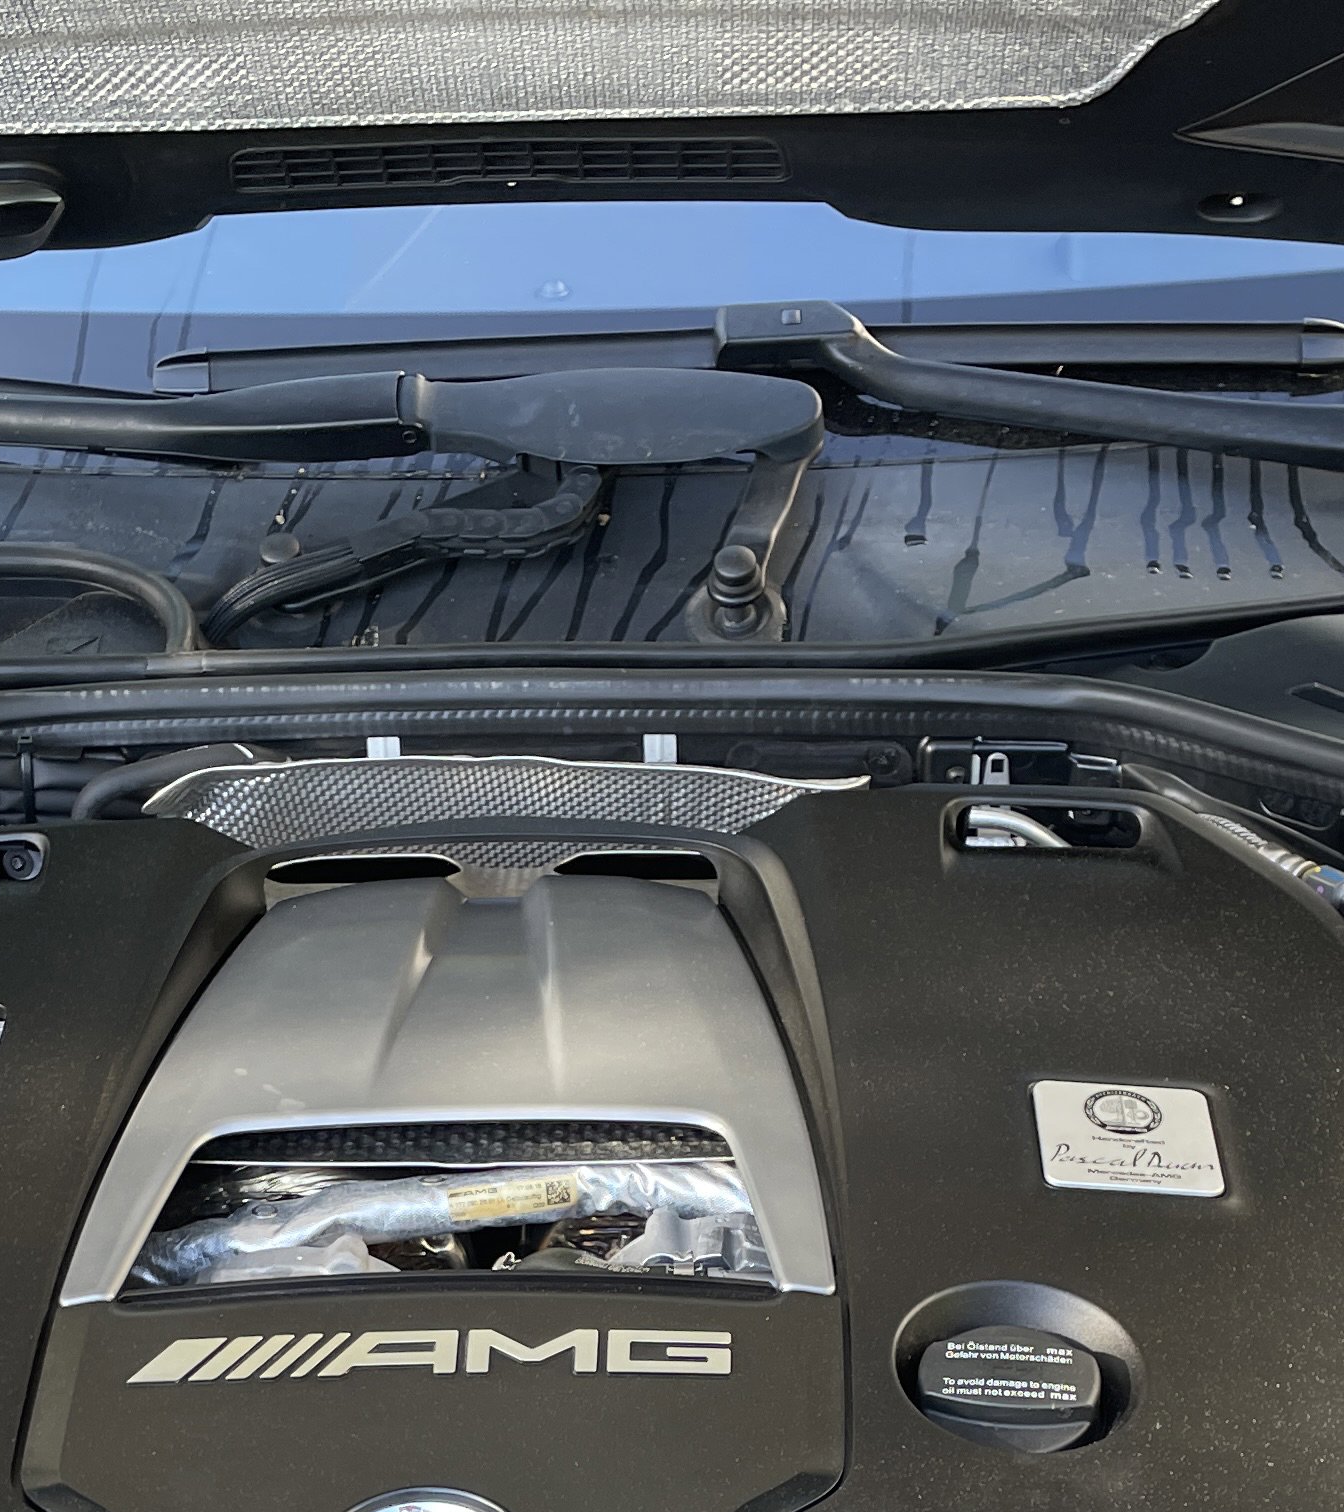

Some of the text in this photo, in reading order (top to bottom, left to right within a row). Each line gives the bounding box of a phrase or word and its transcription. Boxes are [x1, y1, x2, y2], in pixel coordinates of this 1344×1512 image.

[1050, 1143, 1147, 1168] Pascal
[316, 1329, 732, 1378] AMG
[947, 1341, 1073, 1357] Bei Ölstand über max
[945, 1350, 979, 1359] Gefahr
[999, 1353, 1073, 1365] Motorschäden
[942, 1377, 1076, 1392] To avoid damage to engine
[941, 1386, 1077, 1401] oil must not exceed max
